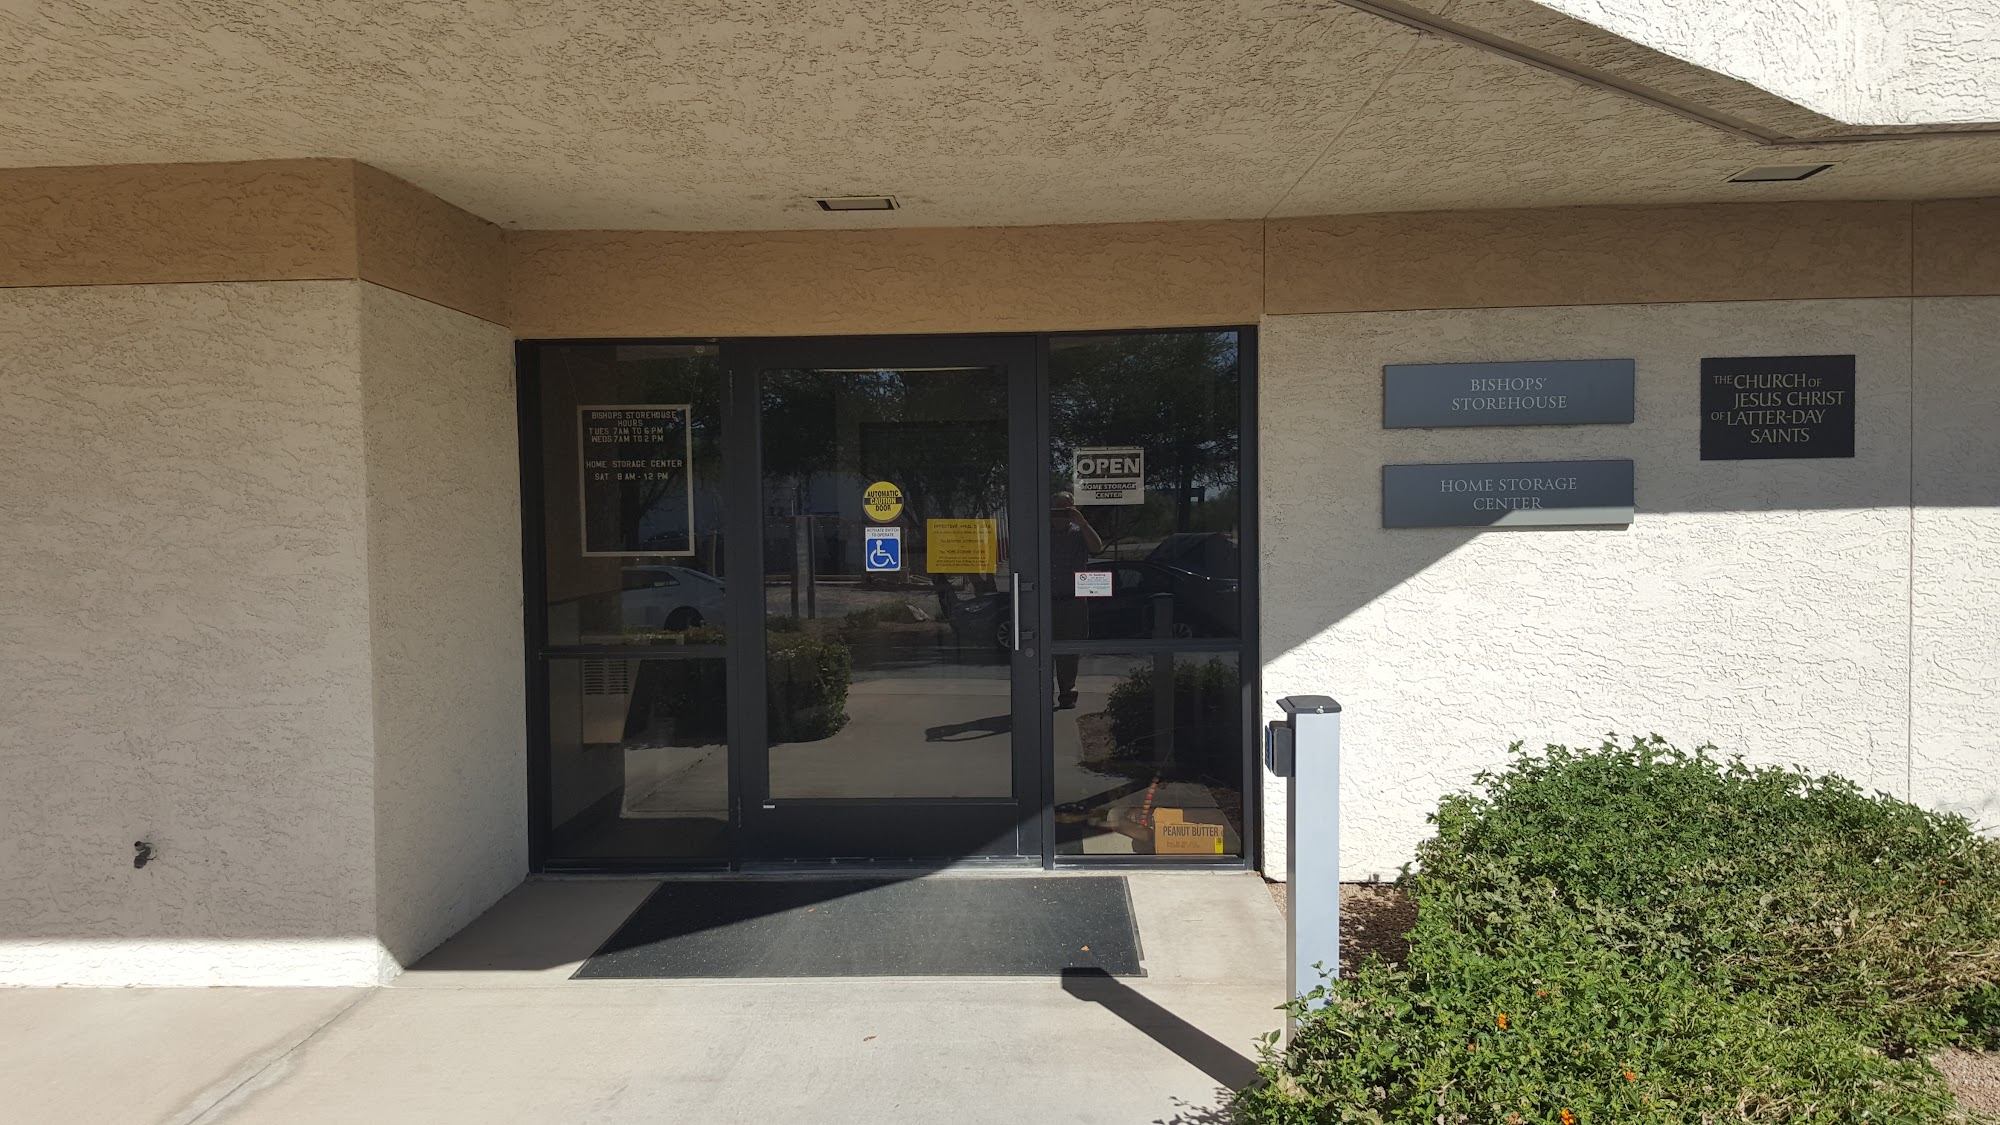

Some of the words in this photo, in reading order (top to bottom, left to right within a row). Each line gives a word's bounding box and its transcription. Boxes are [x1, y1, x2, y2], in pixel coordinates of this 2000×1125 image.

[1470, 377, 1547, 392] BISHOPS'
[1713, 375, 1733, 384] THE
[1734, 373, 1806, 389] CHURCH
[1808, 378, 1822, 388] OF
[1451, 395, 1567, 411] STOREHOUSE
[1734, 391, 1782, 409] JESUS
[1786, 390, 1845, 406] CHRIST
[592, 412, 622, 420] BISHOPS
[626, 411, 676, 419] STOREHOUSE
[1710, 411, 1725, 421] OF
[1727, 408, 1826, 425] LATTER-DAY
[633, 427, 642, 435] TO
[652, 427, 664, 435] PM
[1750, 427, 1810, 444] SAINTS
[633, 435, 642, 443] TO
[644, 435, 649, 443] 2
[652, 435, 664, 443] PM
[612, 460, 646, 468] STORAGE
[650, 460, 683, 468] CENTER
[1078, 458, 1140, 475] OPEN
[625, 472, 635, 480] AM
[658, 472, 668, 480] PM
[1440, 478, 1493, 492] HOME
[1498, 477, 1577, 491] STORAGE
[867, 490, 898, 498] AUTOMATIC
[870, 497, 896, 505] CAUTION
[1472, 496, 1544, 511] CENTER
[1163, 826, 1190, 836] PEANUT
[1192, 826, 1219, 837] BUTTER
